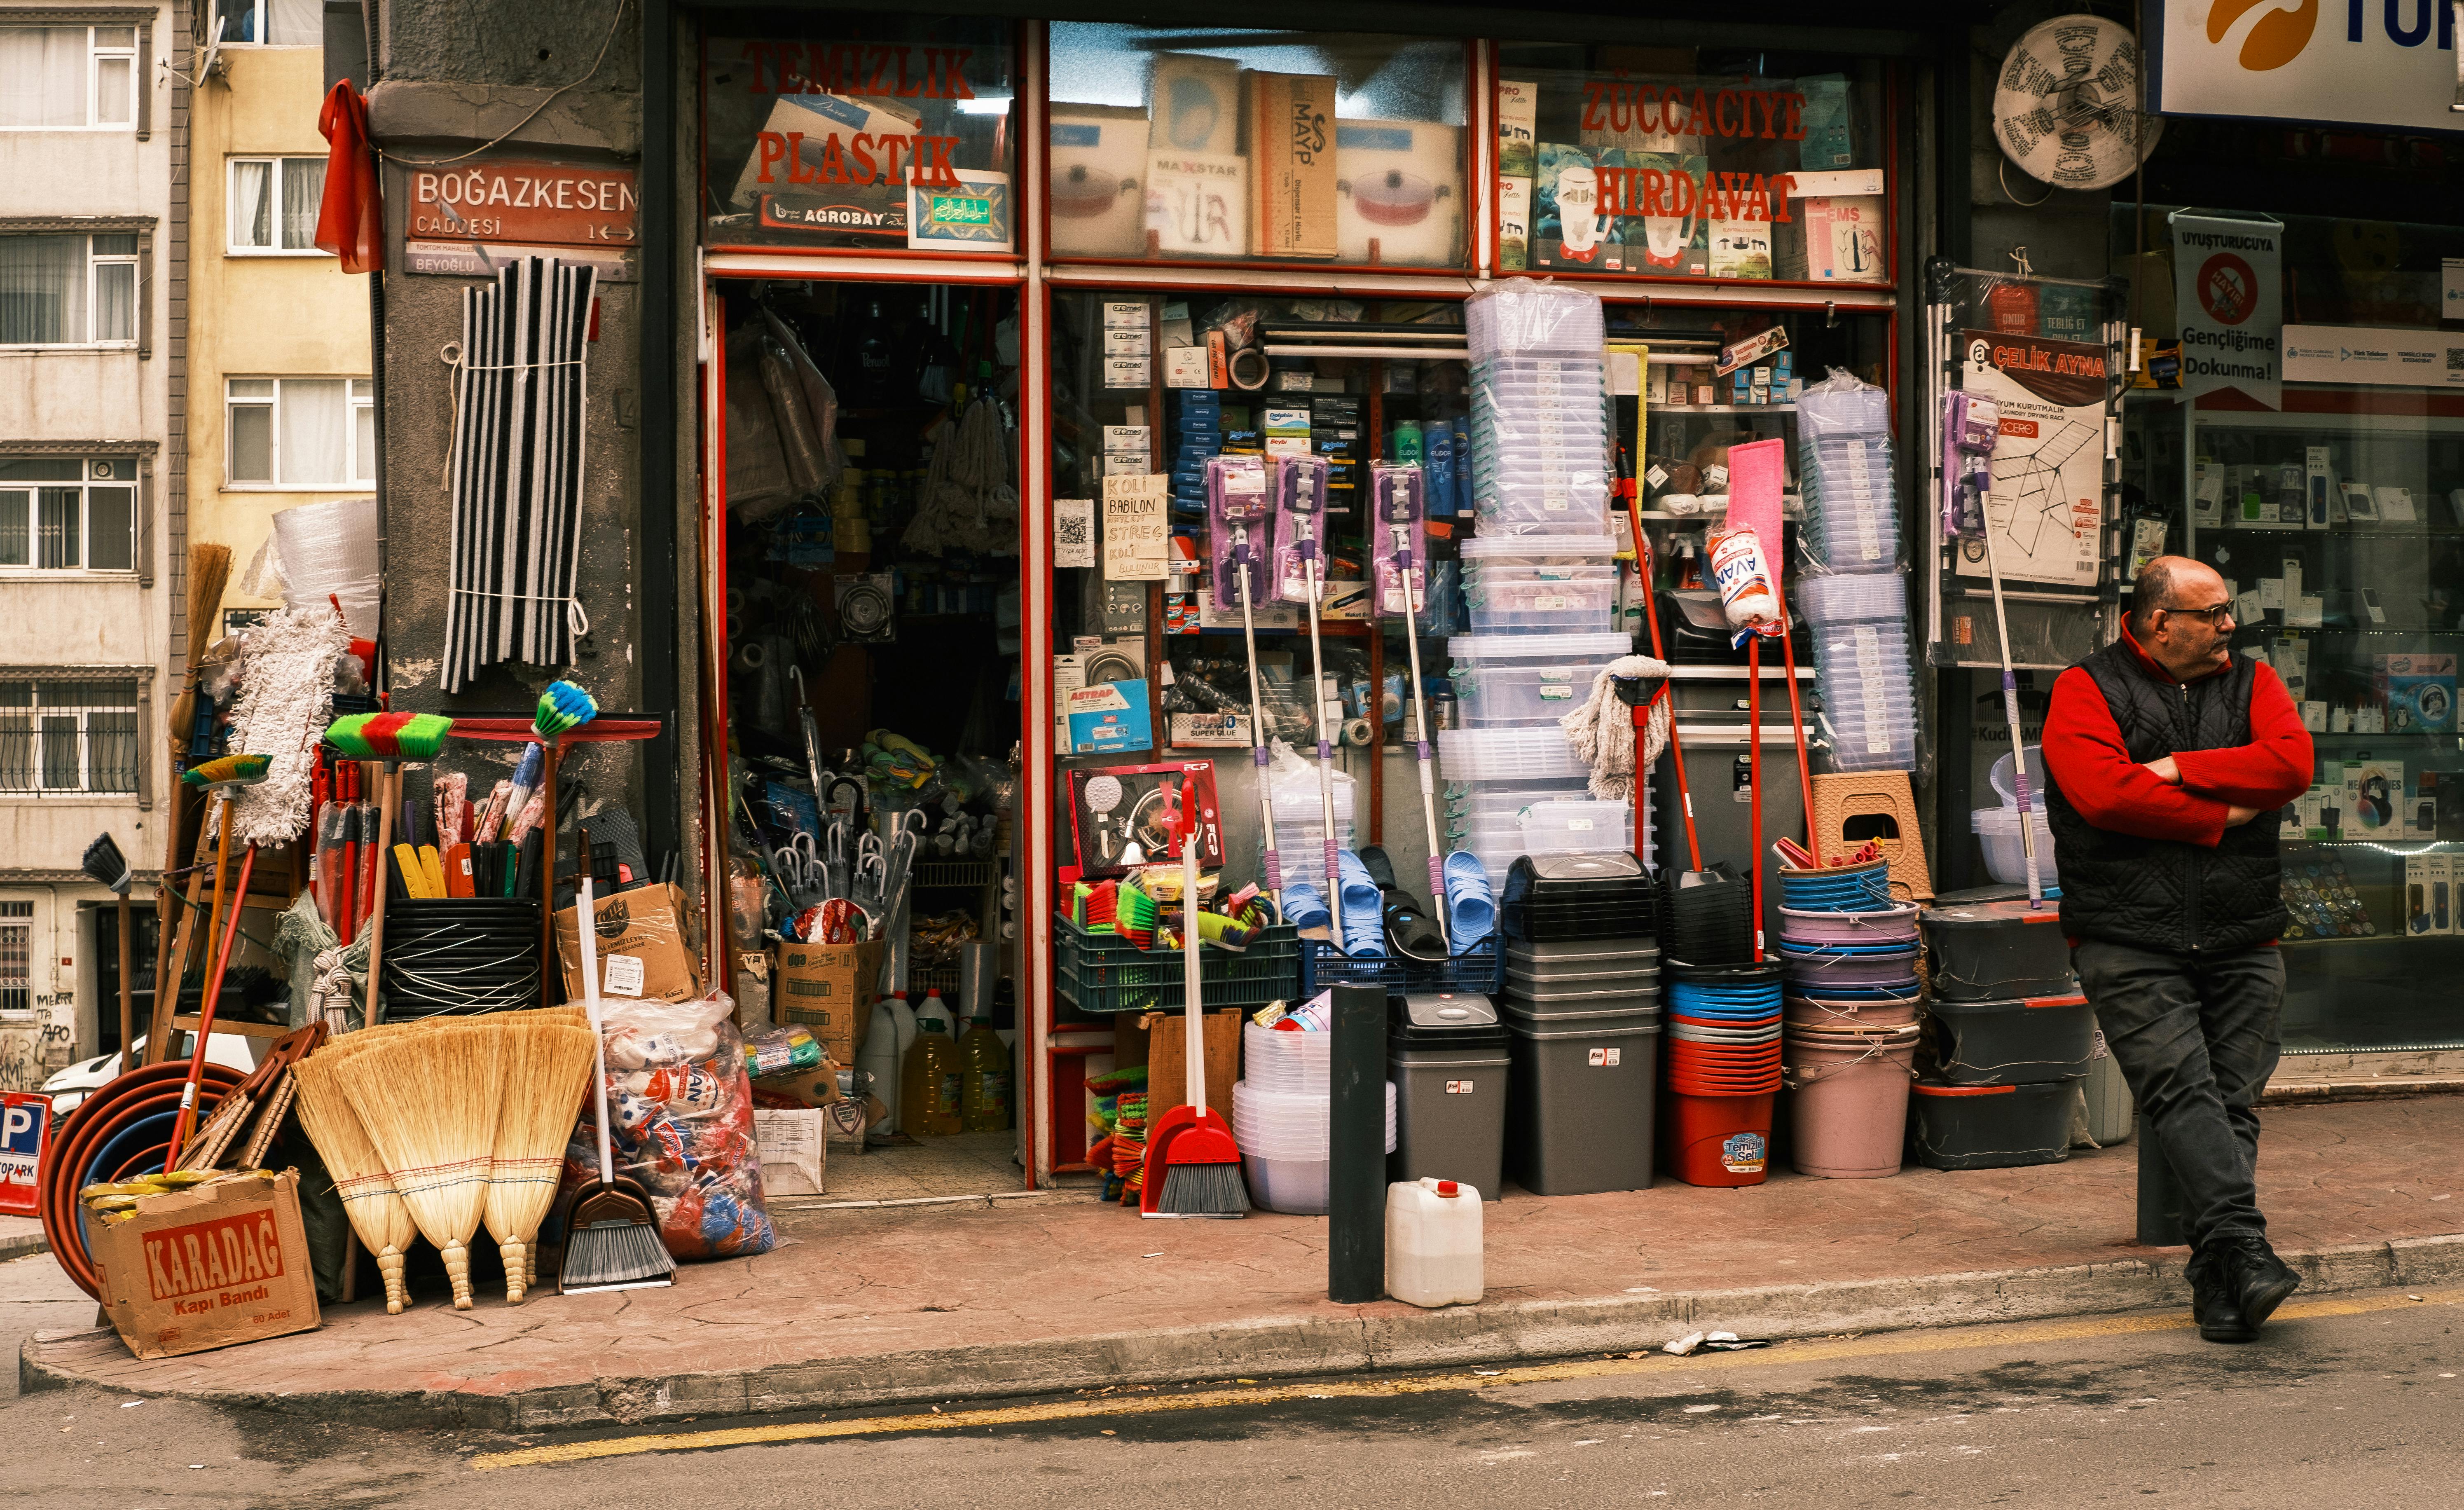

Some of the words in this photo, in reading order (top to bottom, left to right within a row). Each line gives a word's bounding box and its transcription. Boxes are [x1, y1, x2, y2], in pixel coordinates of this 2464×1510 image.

[1582, 68, 1808, 140] ZÜCCACİYE
[757, 118, 962, 187] PLASTİK
[418, 169, 639, 212] BOĞAZKESEN
[1594, 167, 1797, 223] HIRDAVAT
[416, 215, 501, 236] CADDESİ
[588, 224, 597, 240] 1
[804, 209, 884, 226] AGROBAY
[2182, 232, 2274, 252] UYUŞTURUCUYA
[416, 258, 475, 273] BEYOĞLU
[2002, 314, 2026, 325] ONUR
[2047, 316, 2074, 330] TEBLİĞ
[2077, 318, 2086, 330] ET
[2182, 327, 2275, 352] Gençliğime
[1994, 345, 2051, 372] ÇELİK
[2055, 354, 2106, 378] AYNA
[2185, 357, 2272, 381] Dokunma!
[2017, 402, 2065, 414] KURUTMALIK
[1108, 476, 1147, 496] KOLİ
[1109, 497, 1156, 514] BABİLON
[1108, 525, 1163, 541] STREÇ
[1109, 543, 1135, 561] KOLİ
[1070, 688, 1116, 701] ASTRAP
[1183, 763, 1209, 772] FCP
[1206, 823, 1218, 856] FCP
[40, 1023, 70, 1042] APO
[1, 1107, 32, 1148] P
[658, 1126, 681, 1154] AVAN
[1726, 1139, 1764, 1152] Temizlik
[1737, 1150, 1757, 1162] Seti
[146, 1213, 279, 1299] KARADAĞ
[173, 1297, 215, 1316] Kapı
[220, 1285, 270, 1309] Bandı
[267, 1309, 290, 1323] Adet
